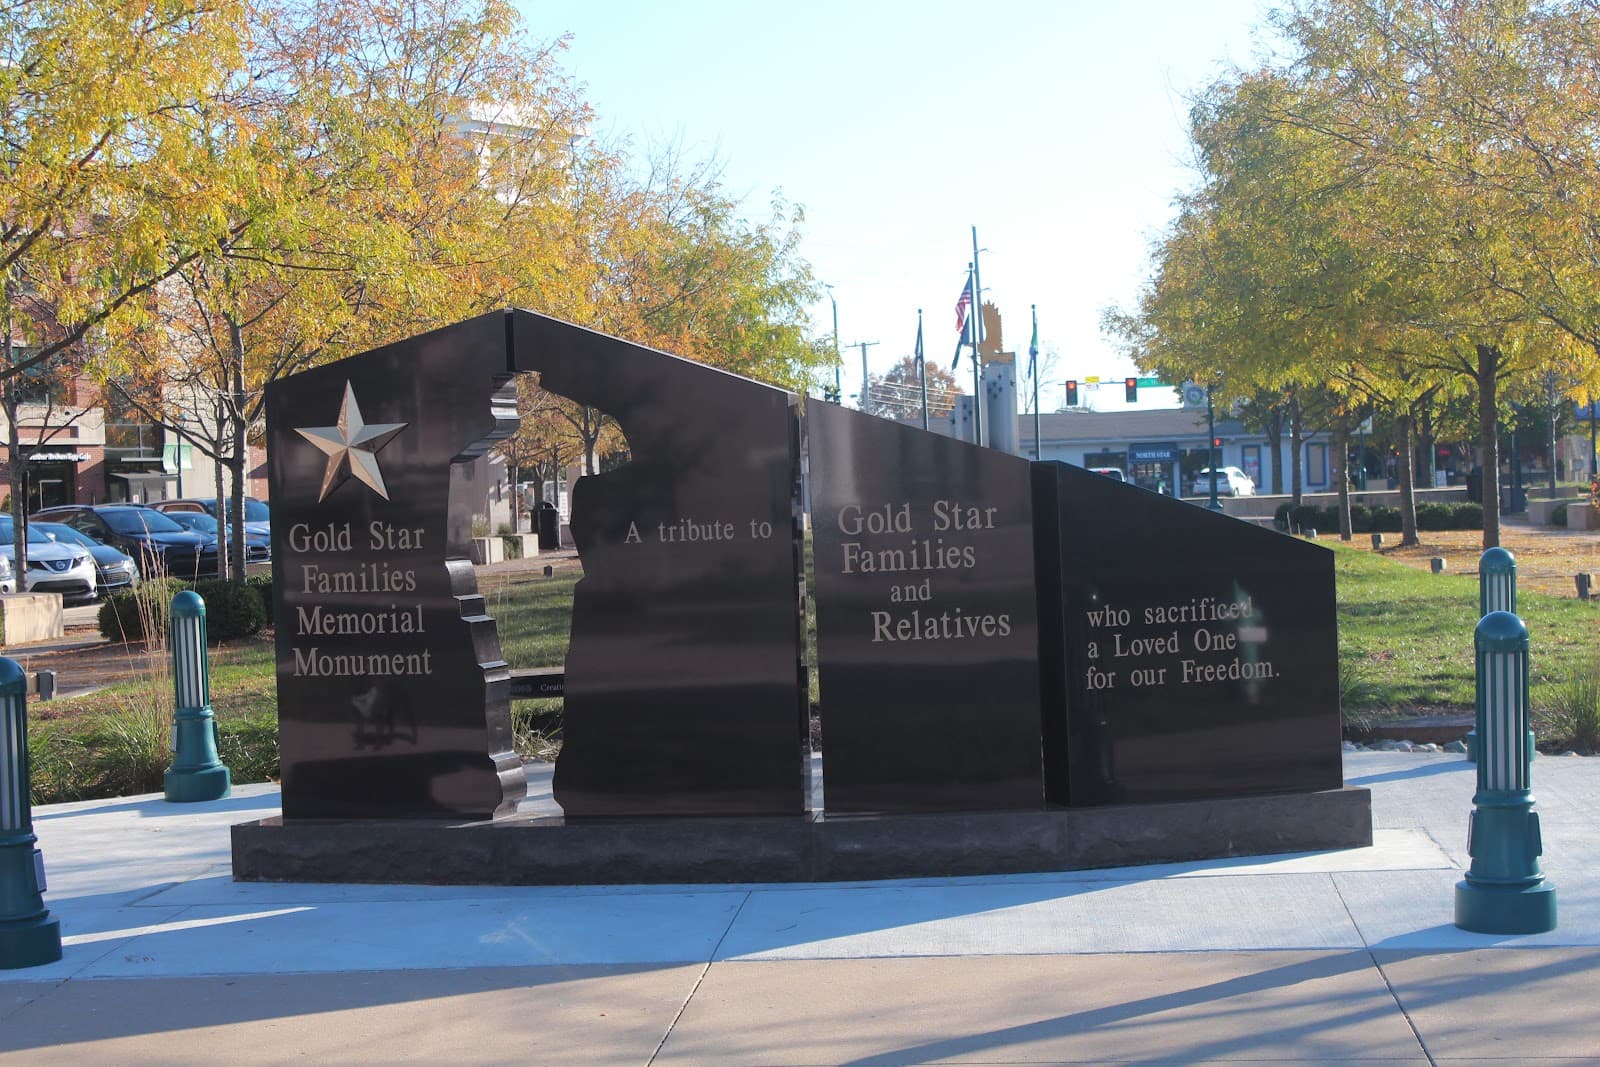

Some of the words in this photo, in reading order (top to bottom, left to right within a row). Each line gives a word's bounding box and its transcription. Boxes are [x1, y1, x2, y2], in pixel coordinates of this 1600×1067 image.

[624, 521, 643, 544] A
[658, 518, 735, 543] tribute
[750, 518, 772, 539] to
[838, 502, 913, 535] Gold
[933, 500, 998, 531] Star
[289, 521, 352, 552] Gold
[370, 521, 425, 550] Star
[841, 538, 976, 574] Families
[301, 562, 417, 594] Families
[890, 578, 932, 602] and
[296, 603, 426, 636] Memorial
[871, 608, 1011, 642] Relatives
[1087, 604, 1130, 628] who
[1144, 596, 1253, 625] sacrificed
[1088, 641, 1099, 658] a
[1114, 631, 1180, 657] Loved
[1194, 628, 1236, 652] One
[292, 647, 433, 677] Monument
[1086, 666, 1116, 690] for
[1131, 667, 1167, 687] our
[1181, 657, 1280, 684] Freedom.
